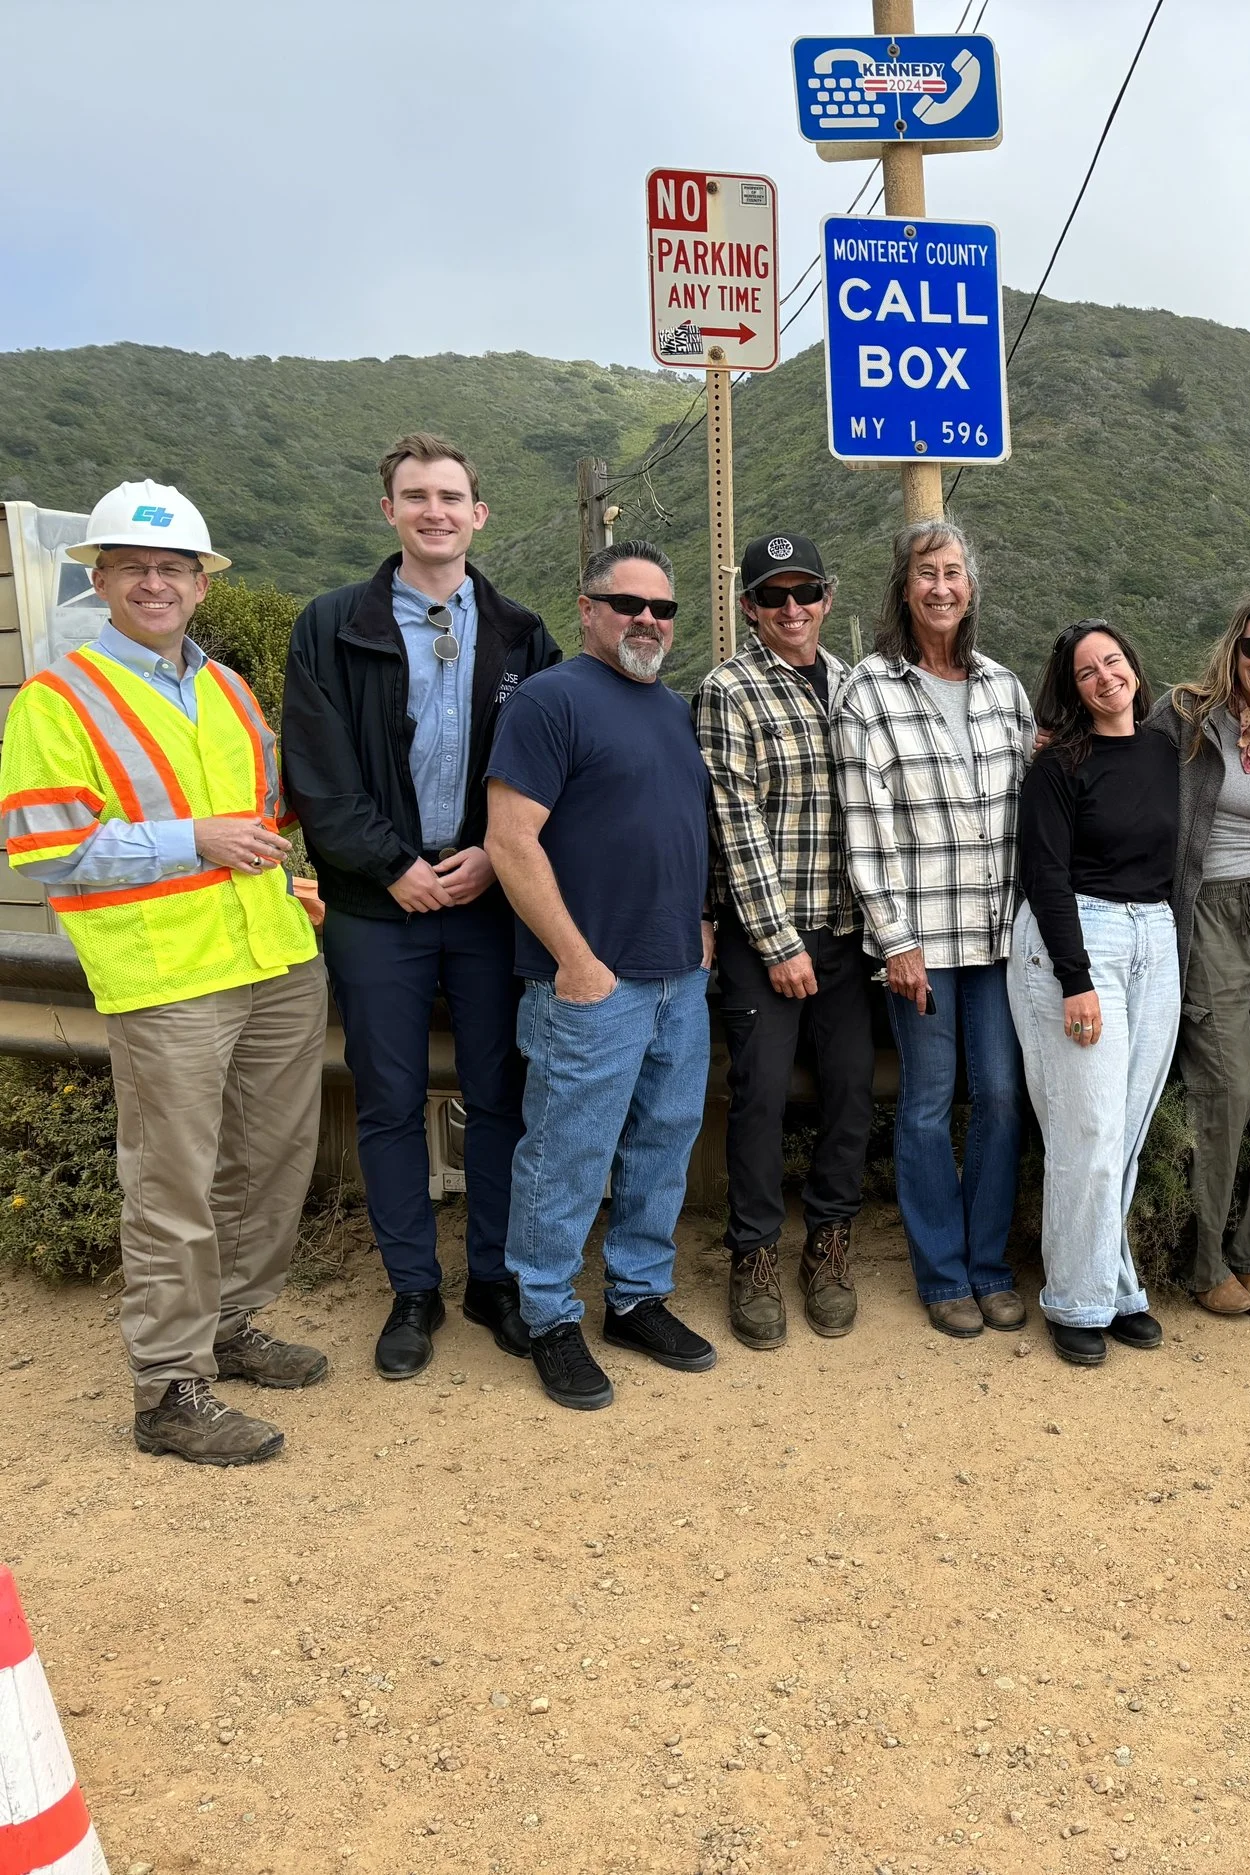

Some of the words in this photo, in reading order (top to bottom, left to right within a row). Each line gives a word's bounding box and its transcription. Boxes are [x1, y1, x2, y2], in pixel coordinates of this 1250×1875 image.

[862, 63, 944, 77] KENNEDY
[889, 79, 922, 92] 2024
[656, 178, 701, 222] NO
[657, 238, 769, 280] PARKING
[833, 238, 919, 263] MONTEREY
[926, 243, 988, 267] COUNTY
[668, 283, 711, 310] ANY
[717, 285, 762, 313] TIME
[838, 277, 989, 325] CALL
[858, 345, 971, 390] BOX
[850, 416, 885, 440] MY
[909, 420, 917, 442] 1
[942, 421, 989, 447] 596
